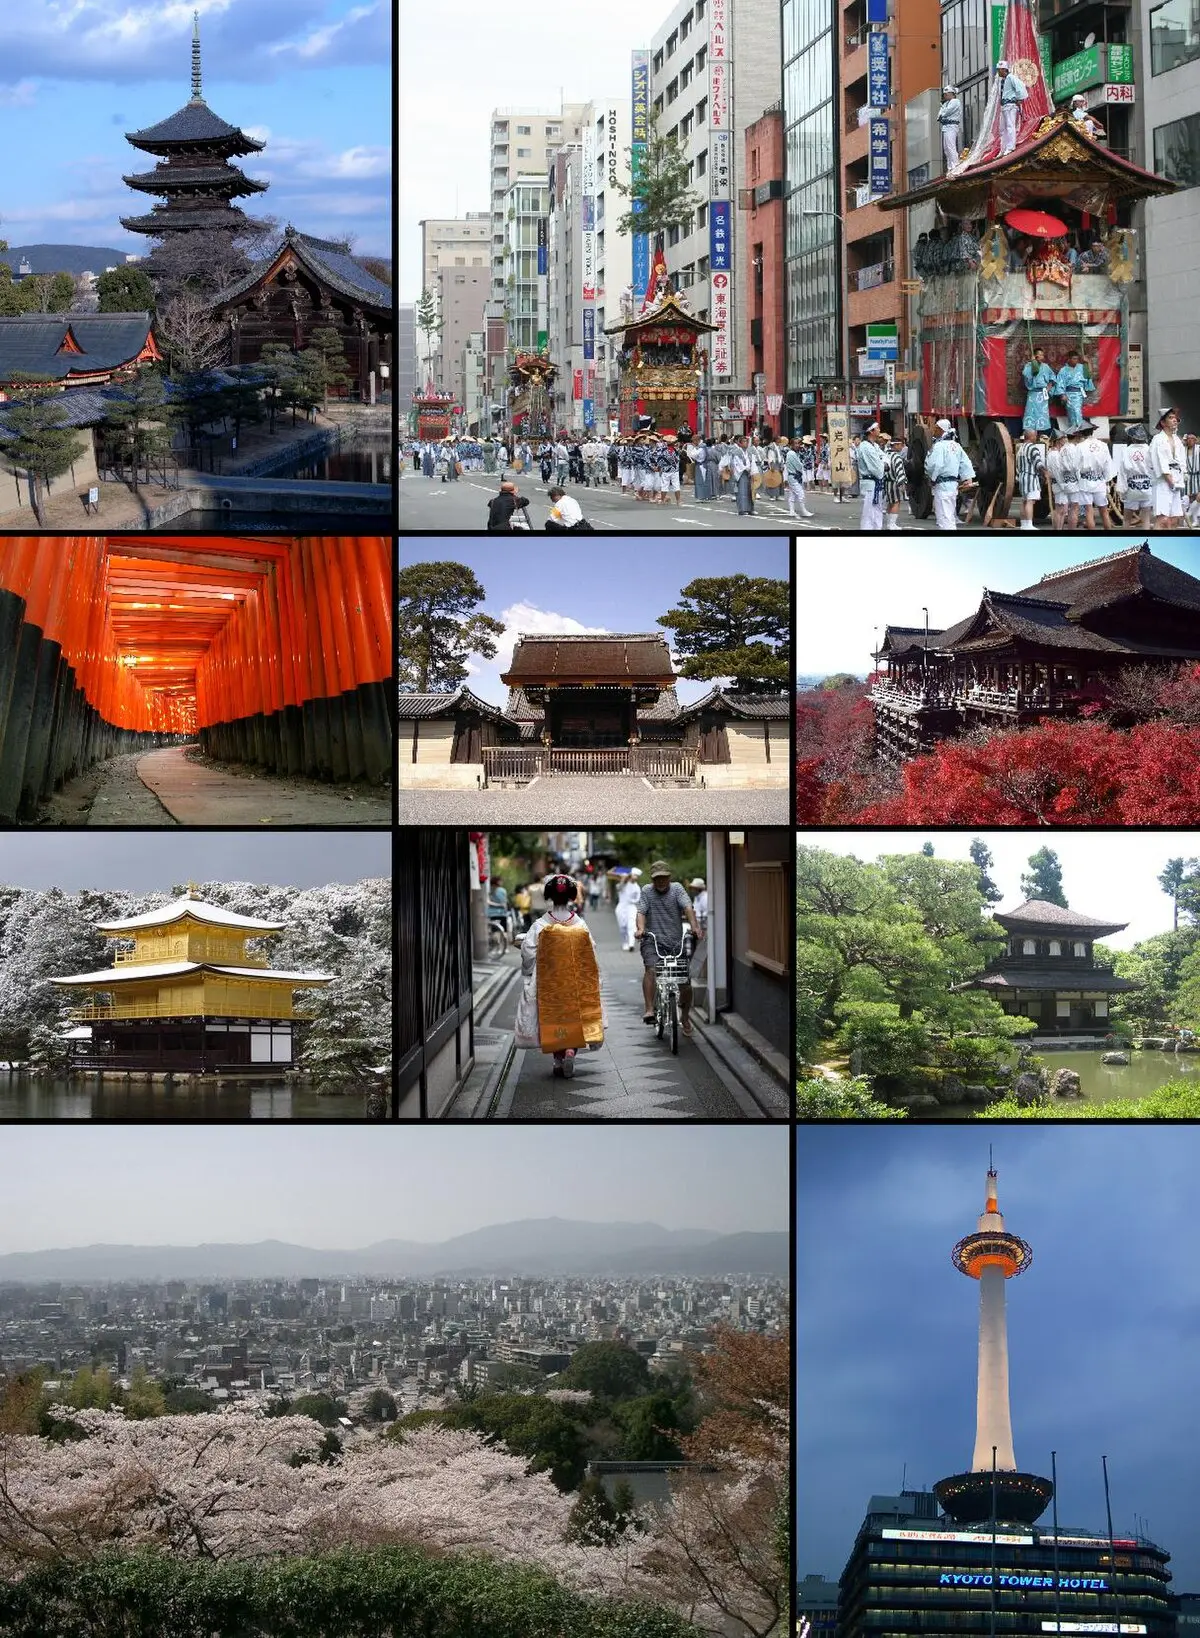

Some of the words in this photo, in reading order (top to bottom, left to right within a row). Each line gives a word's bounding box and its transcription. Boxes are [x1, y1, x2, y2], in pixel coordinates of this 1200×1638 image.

[1106, 86, 1133, 102] 内科
[715, 293, 728, 373] 東海東京証券
[834, 430, 846, 472] 岩戸山
[939, 1573, 993, 1585] KYOTO
[999, 1575, 1053, 1587] TOWER
[1058, 1577, 1109, 1589] HOTEL
